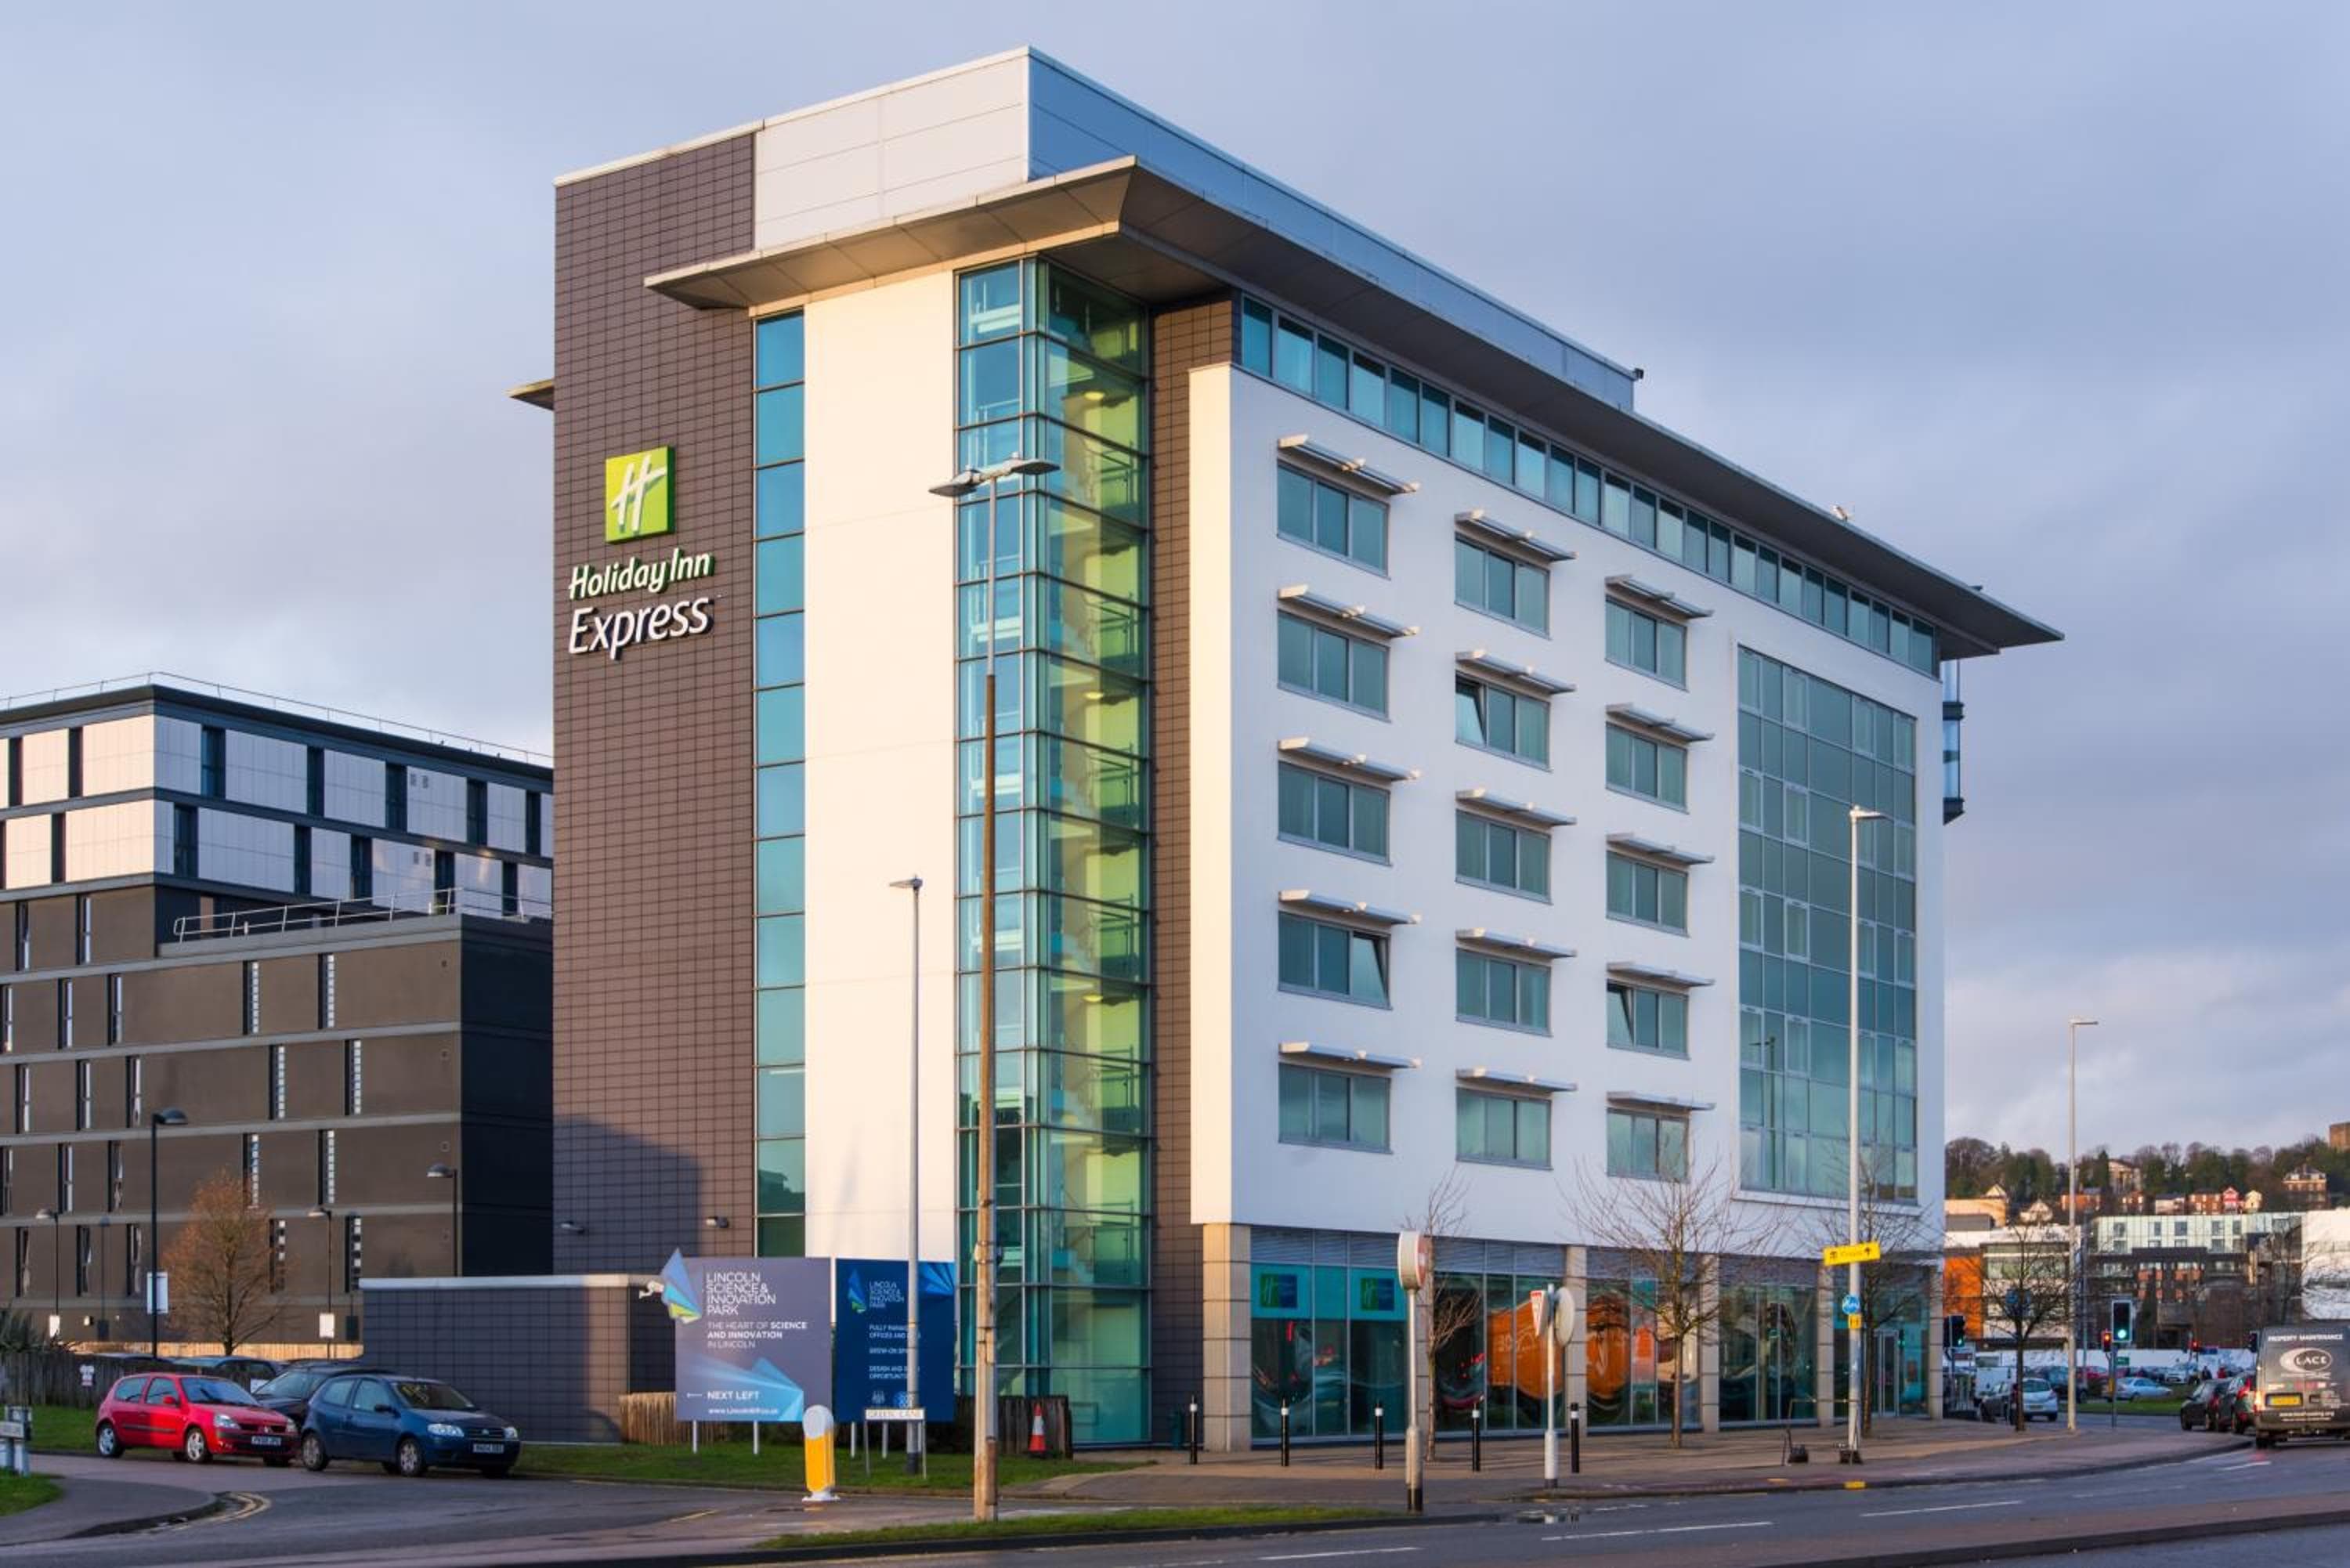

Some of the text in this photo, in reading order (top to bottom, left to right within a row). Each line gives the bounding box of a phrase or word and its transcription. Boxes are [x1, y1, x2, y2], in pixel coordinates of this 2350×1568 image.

[569, 547, 712, 601] Holiday Inn
[569, 597, 711, 660] Express
[707, 1272, 761, 1283] LINCOLN
[707, 1293, 777, 1304] INNOVATION
[707, 1304, 739, 1315] PARK
[707, 1321, 808, 1330] THE HEART OF SCIENCE
[718, 1340, 756, 1349] LINCOLN
[707, 1390, 759, 1400] NEXT LEFT
